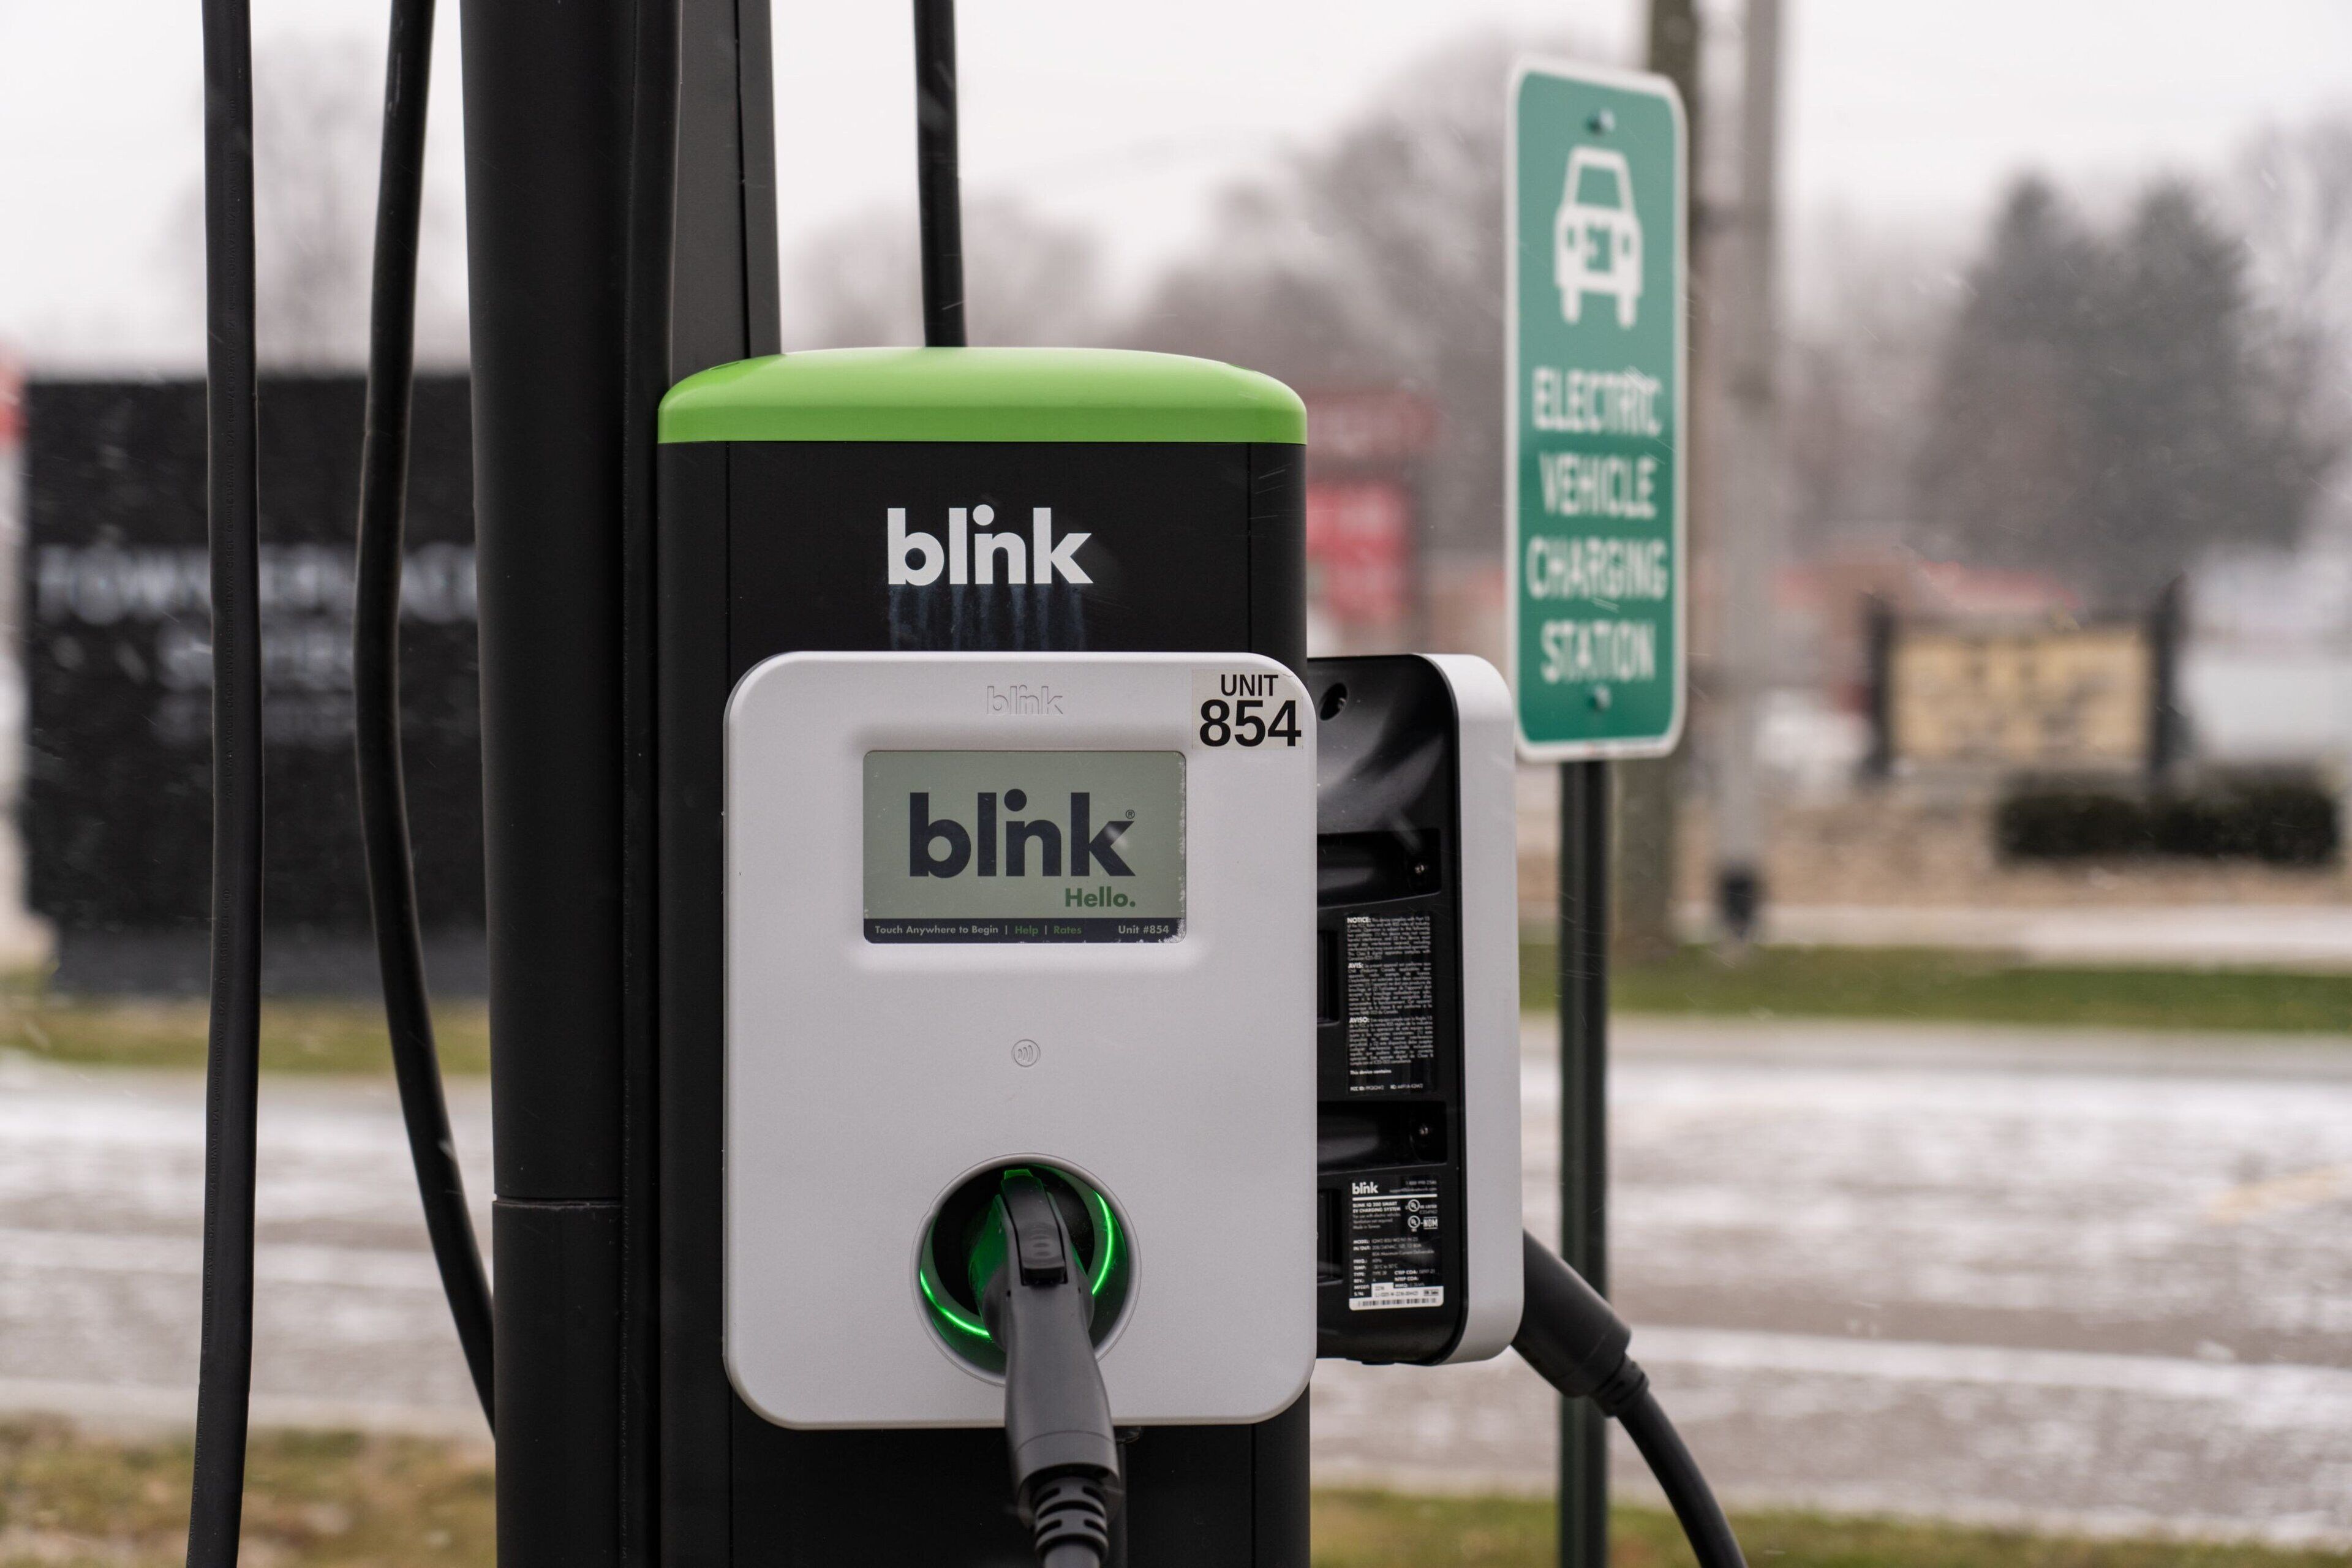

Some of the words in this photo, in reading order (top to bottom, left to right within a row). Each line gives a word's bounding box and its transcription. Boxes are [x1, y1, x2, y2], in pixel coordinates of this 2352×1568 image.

[1532, 368, 1662, 436] ELECTRIC
[1540, 451, 1656, 518] VEHICLE
[888, 504, 1094, 586] blink
[1526, 534, 1667, 600] CHARGING
[1542, 619, 1656, 682] STATION
[987, 684, 1063, 716] blink
[1221, 674, 1279, 696] UNIT
[1199, 699, 1302, 747] 854
[910, 788, 1136, 879] blink
[1065, 886, 1136, 908] Hello.
[875, 925, 903, 934] Touch
[906, 925, 956, 936] Anywhere
[959, 925, 969, 934] to
[971, 925, 999, 936] Begin
[1014, 925, 1039, 936] Help
[1053, 925, 1082, 935] Rates
[1118, 925, 1139, 934] Unit
[1143, 925, 1170, 935] #854
[1352, 1182, 1378, 1194] blink
